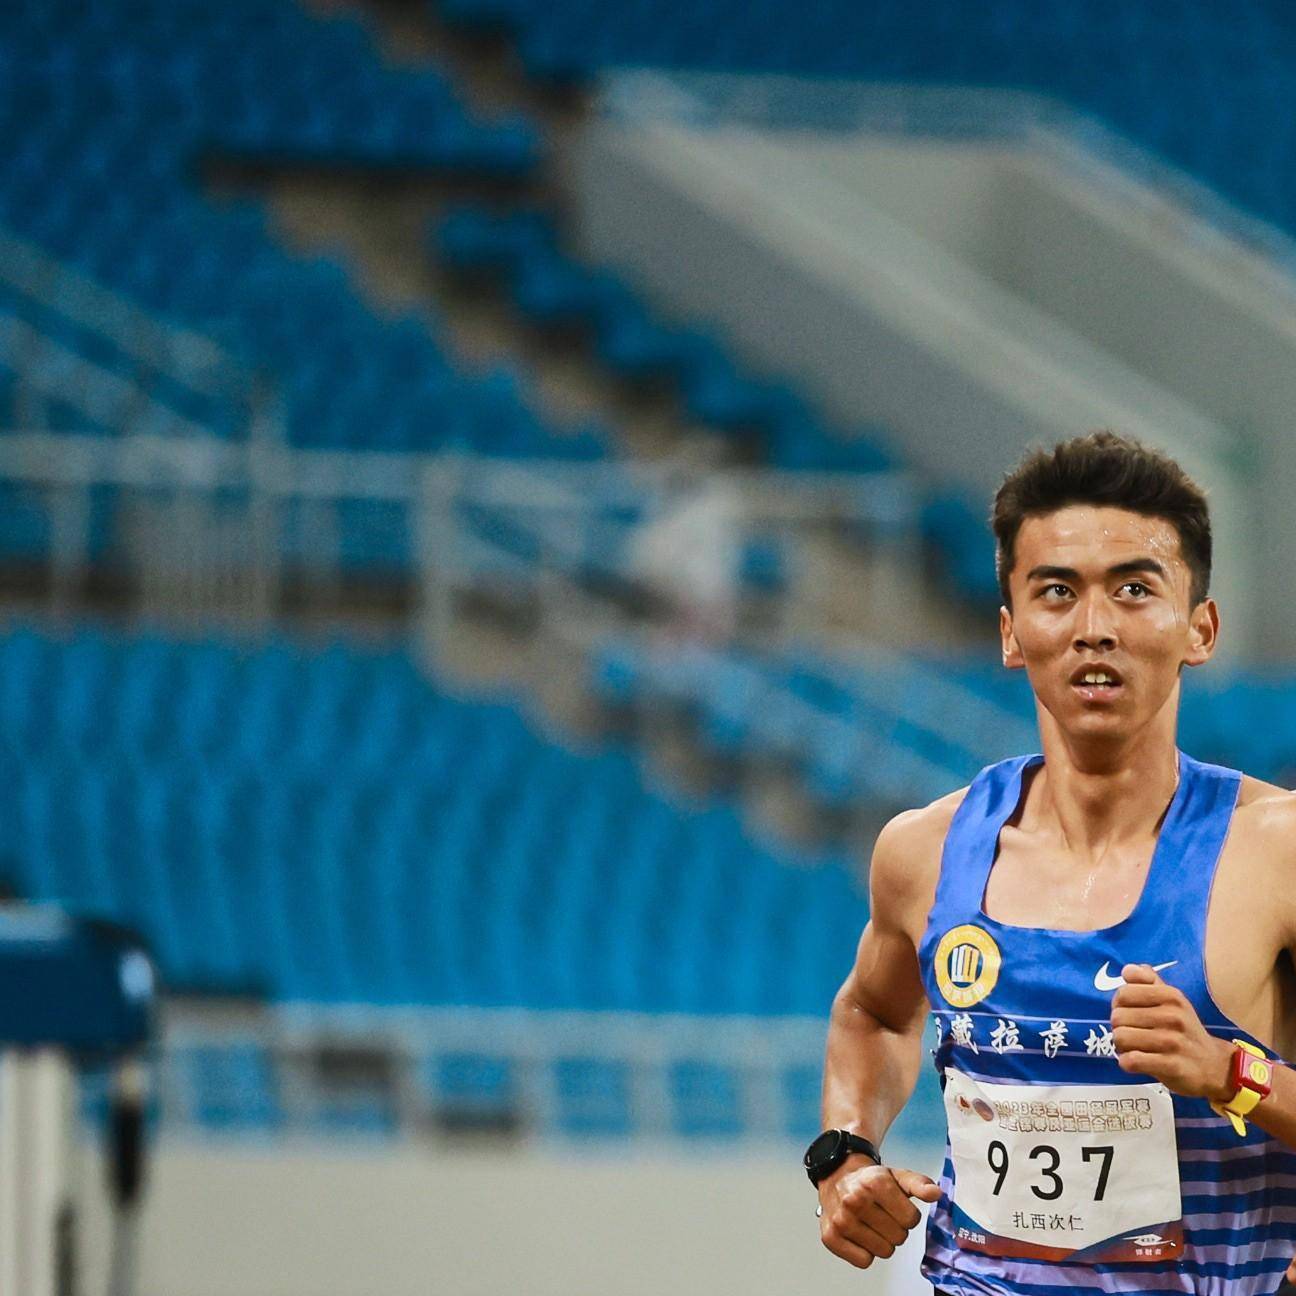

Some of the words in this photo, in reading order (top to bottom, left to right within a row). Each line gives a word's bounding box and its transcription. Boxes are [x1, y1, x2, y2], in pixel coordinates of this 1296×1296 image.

[987, 1140, 1115, 1202] 937
[1012, 1211, 1085, 1232] 扎西次仁
